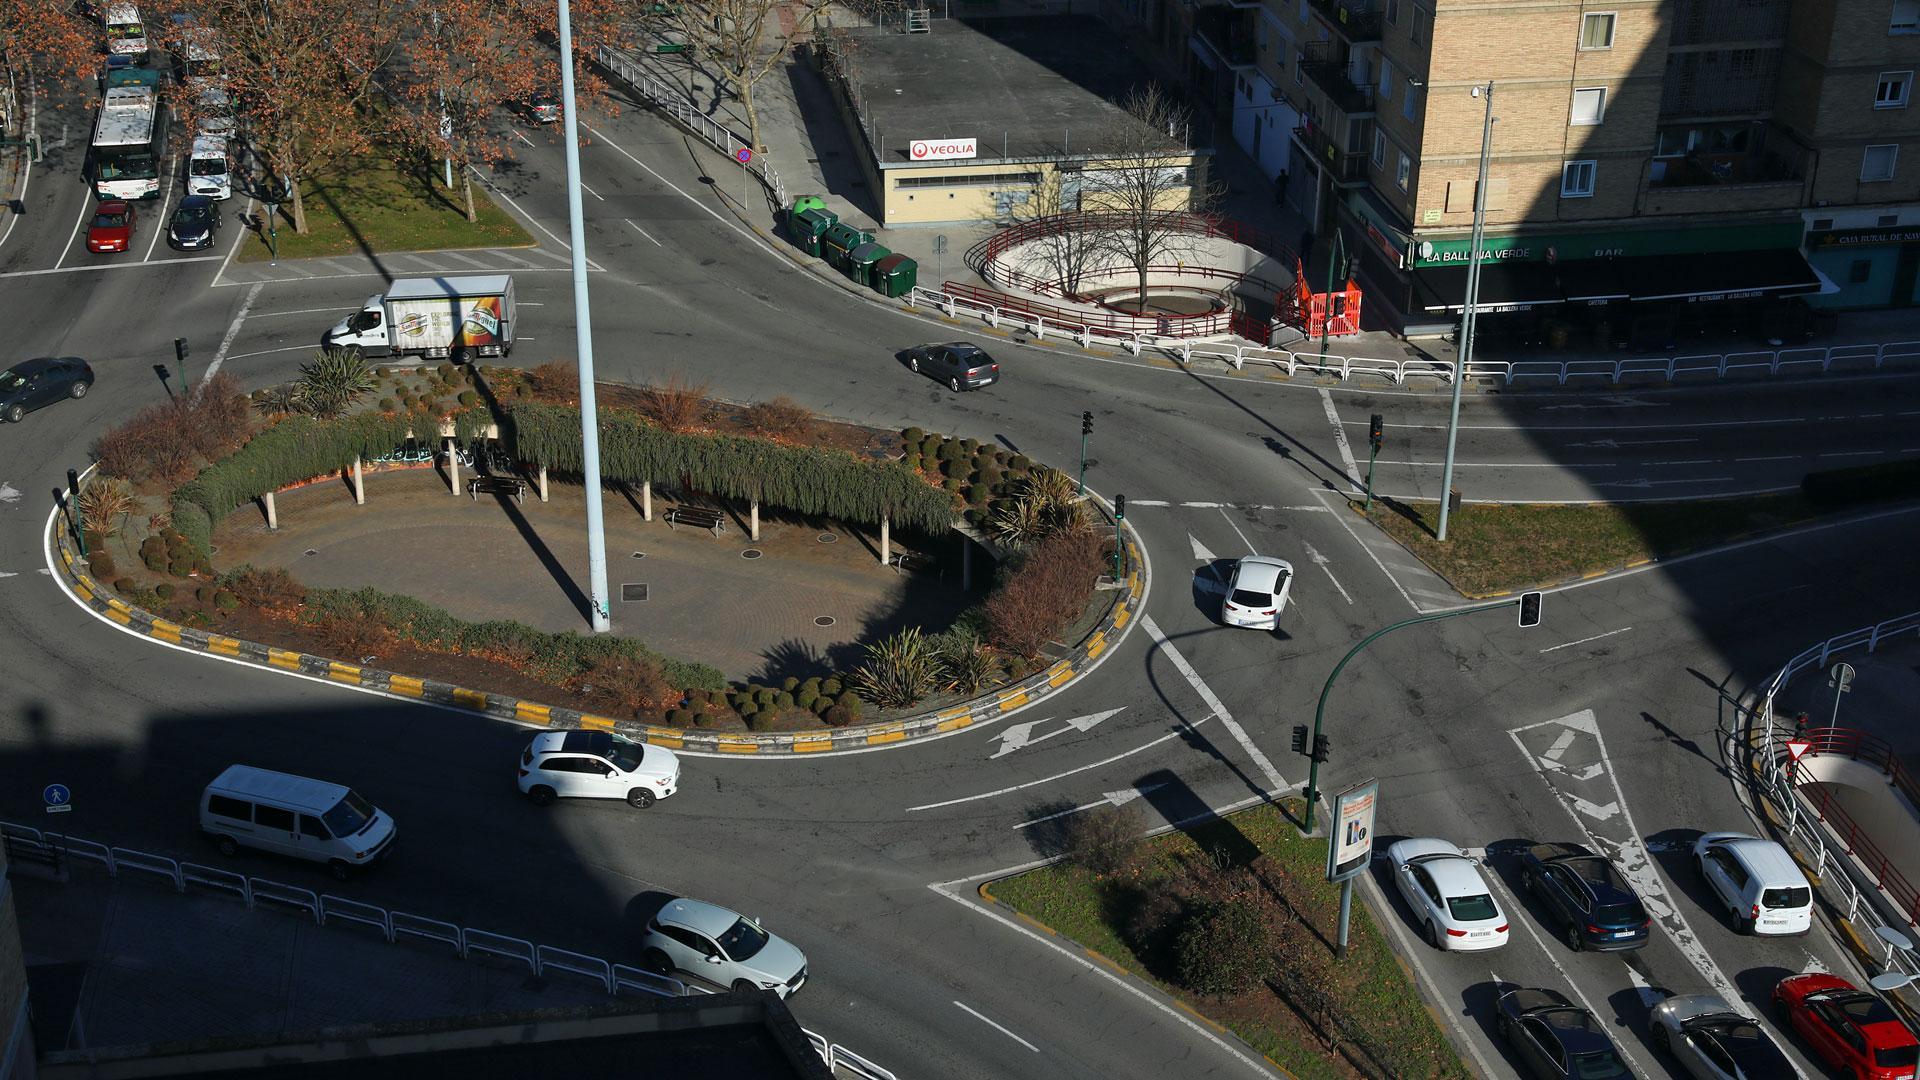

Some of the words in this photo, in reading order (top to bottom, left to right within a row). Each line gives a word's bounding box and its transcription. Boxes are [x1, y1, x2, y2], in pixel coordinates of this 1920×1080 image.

[930, 144, 974, 154] VEOLIA
[1860, 234, 1888, 242] RURAL
[1890, 233, 1902, 241] DE
[1495, 248, 1530, 259] VERDE
[1593, 248, 1624, 257] BAR
